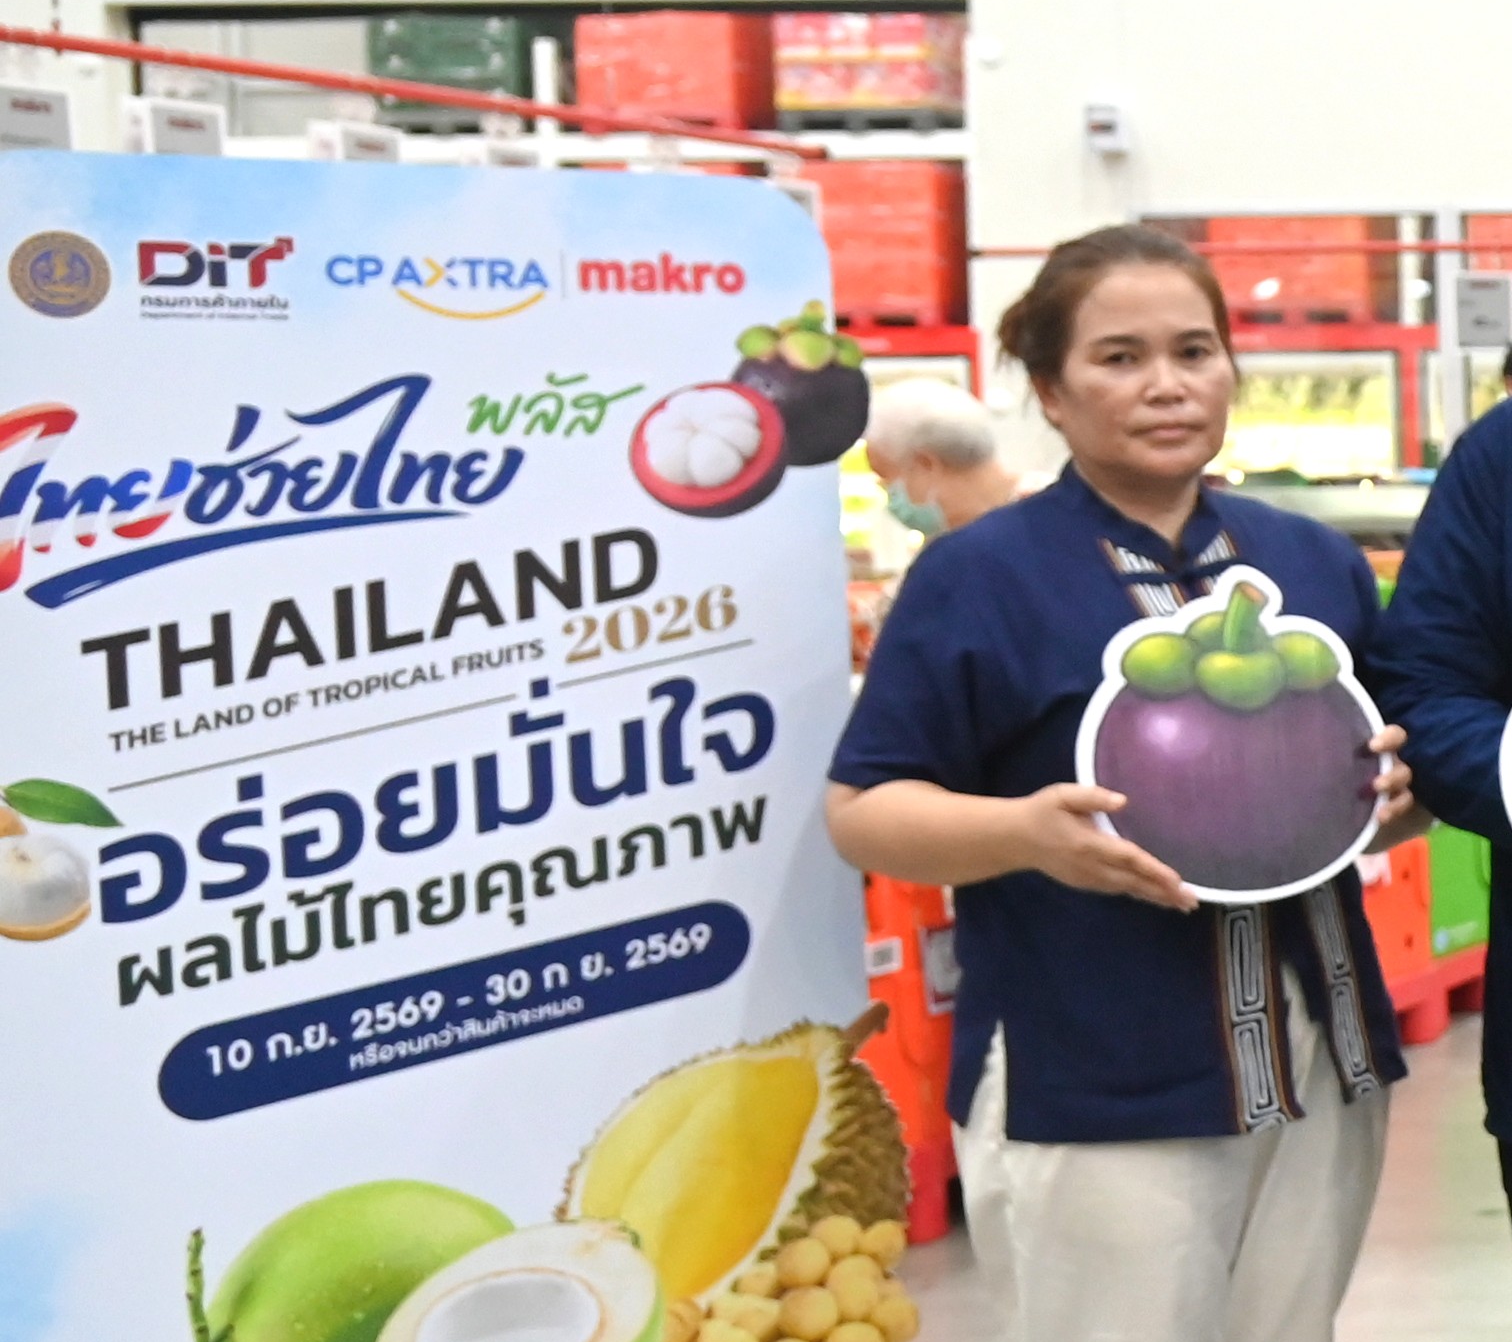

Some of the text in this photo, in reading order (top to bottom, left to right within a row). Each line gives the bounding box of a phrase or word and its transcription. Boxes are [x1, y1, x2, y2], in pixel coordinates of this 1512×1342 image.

[326, 256, 547, 291] CP AXTRA
[578, 252, 745, 294] makro
[465, 371, 646, 438] พลัส
[81, 528, 660, 711] THAILAND
[561, 583, 739, 664] 2026
[109, 638, 546, 752] THE LAND OF TROPICAL FRUITS
[98, 677, 776, 925] อร่อยมั่นใจ
[116, 795, 769, 1008] ผลไม้ไทยคุณภาพ
[206, 1040, 253, 1077] 10
[266, 1020, 338, 1063] ก.ย.
[351, 989, 445, 1042] 2569
[456, 995, 474, 1008] -
[485, 970, 531, 1006] 30
[625, 923, 713, 971] 2569
